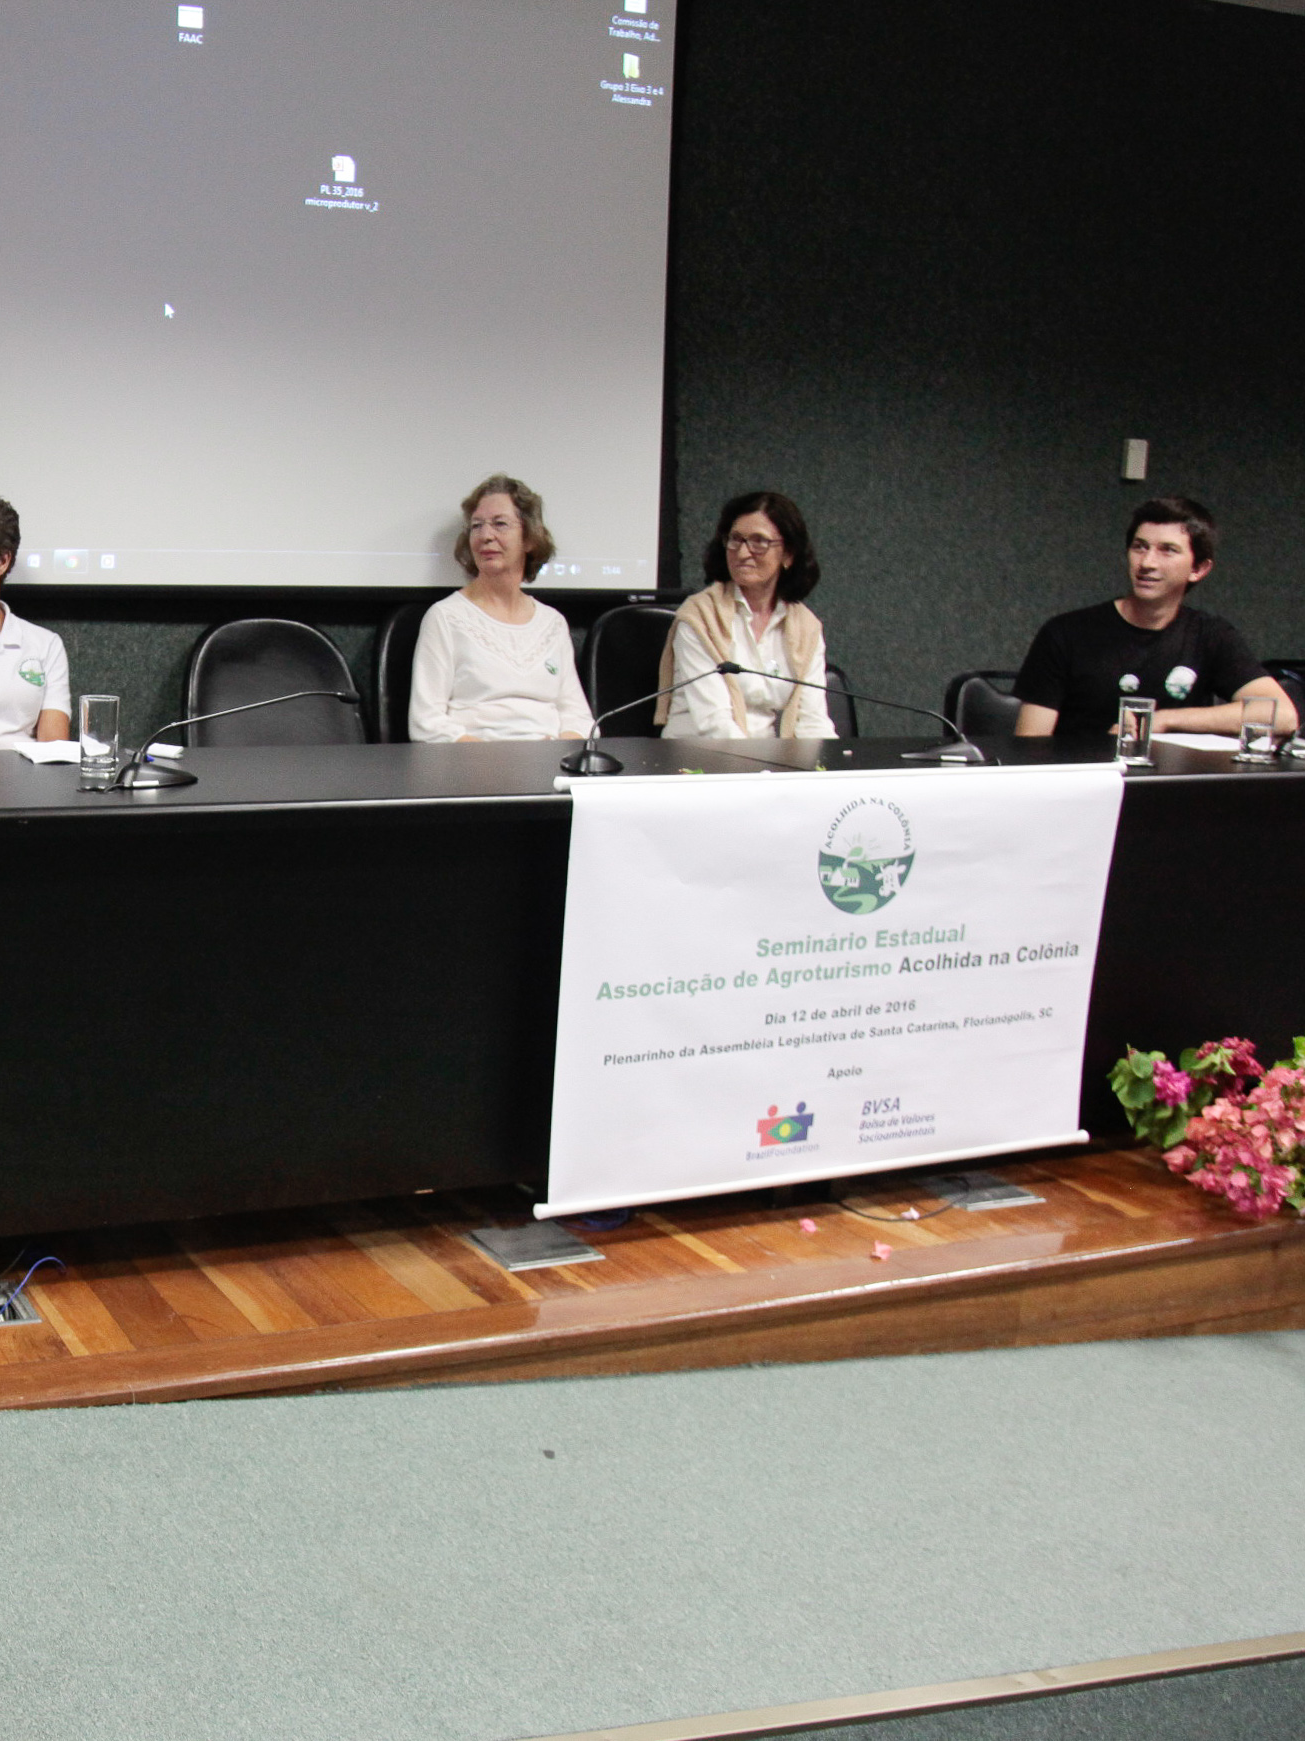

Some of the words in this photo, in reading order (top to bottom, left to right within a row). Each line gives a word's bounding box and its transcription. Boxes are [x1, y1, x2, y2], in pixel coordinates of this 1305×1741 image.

[649, 20, 660, 30] de
[178, 32, 204, 44] FAAC
[600, 80, 624, 92] Grupo
[320, 184, 331, 195] PL
[824, 797, 866, 850] ACOLHIDA
[870, 796, 884, 806] NA
[888, 802, 912, 851] COLÔNIA
[756, 932, 868, 958] Seminário
[875, 924, 966, 948] Estadual
[596, 974, 726, 1001] Associação
[733, 970, 758, 989] de
[766, 962, 892, 988] Agroturismo
[898, 952, 982, 974] Acolhida
[988, 952, 1010, 966] na
[1016, 941, 1080, 964] Colônia
[765, 1012, 786, 1026] Dia
[792, 1010, 806, 1022] 12
[810, 1008, 827, 1021] de
[831, 1002, 862, 1018] abril
[865, 1001, 881, 1015] de
[886, 1000, 916, 1014] 2016
[603, 1048, 675, 1066] Plenarinho
[679, 1046, 696, 1058] da
[700, 1037, 774, 1056] Assembléia
[778, 1032, 847, 1048] Legislativa
[850, 1029, 866, 1040] de
[868, 1026, 903, 1038] Santa
[907, 1019, 960, 1034] Catarina,
[963, 1010, 1036, 1029] Florianópolis,
[1039, 1007, 1053, 1018] SC
[827, 1066, 862, 1082] Apoio
[862, 1097, 900, 1116] BVSA
[859, 1118, 885, 1130] Bolsa
[887, 1116, 898, 1126] de
[901, 1113, 935, 1126] Valores
[858, 1127, 936, 1144] Socioambientais
[746, 1142, 820, 1161] BrazilFoundation
